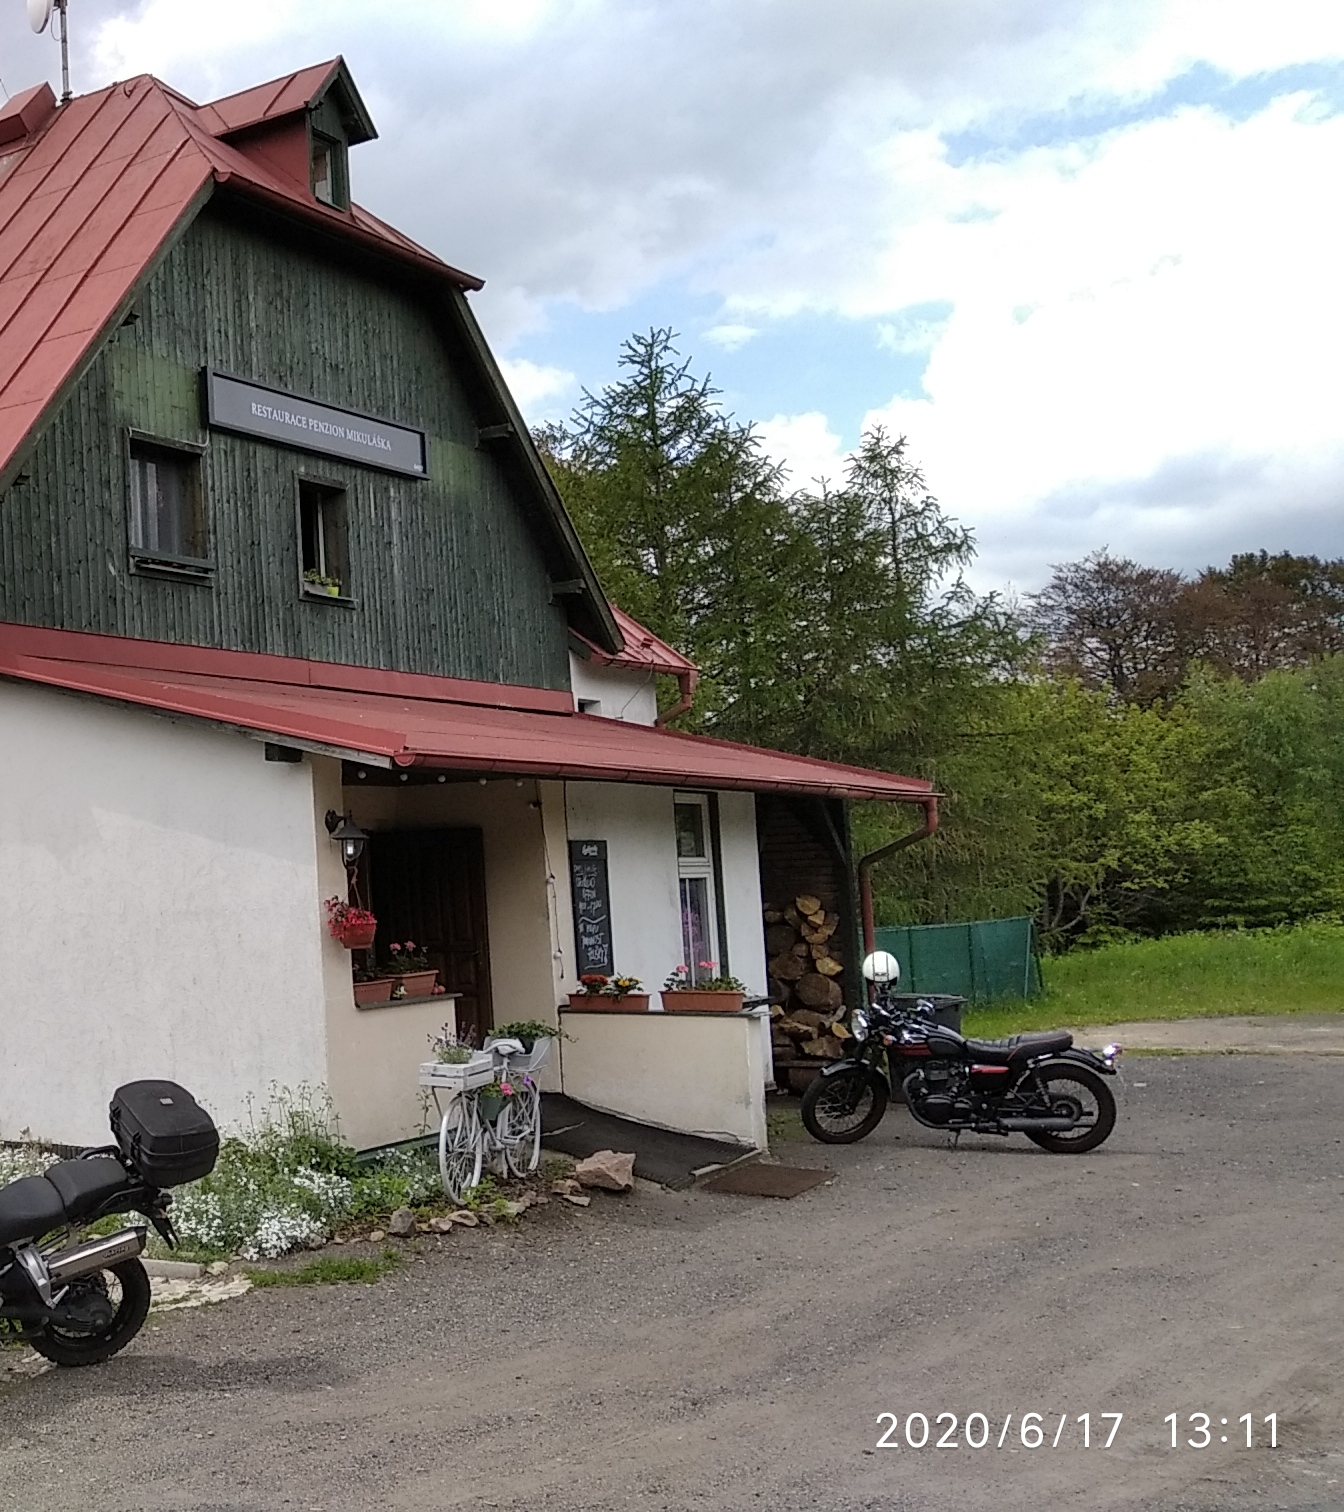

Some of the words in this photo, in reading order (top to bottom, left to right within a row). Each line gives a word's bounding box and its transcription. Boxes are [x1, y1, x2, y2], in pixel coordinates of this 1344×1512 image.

[251, 402, 307, 428] RESTAURACE
[308, 417, 345, 439] PENZION
[346, 428, 392, 451] MIKULÁŠKA
